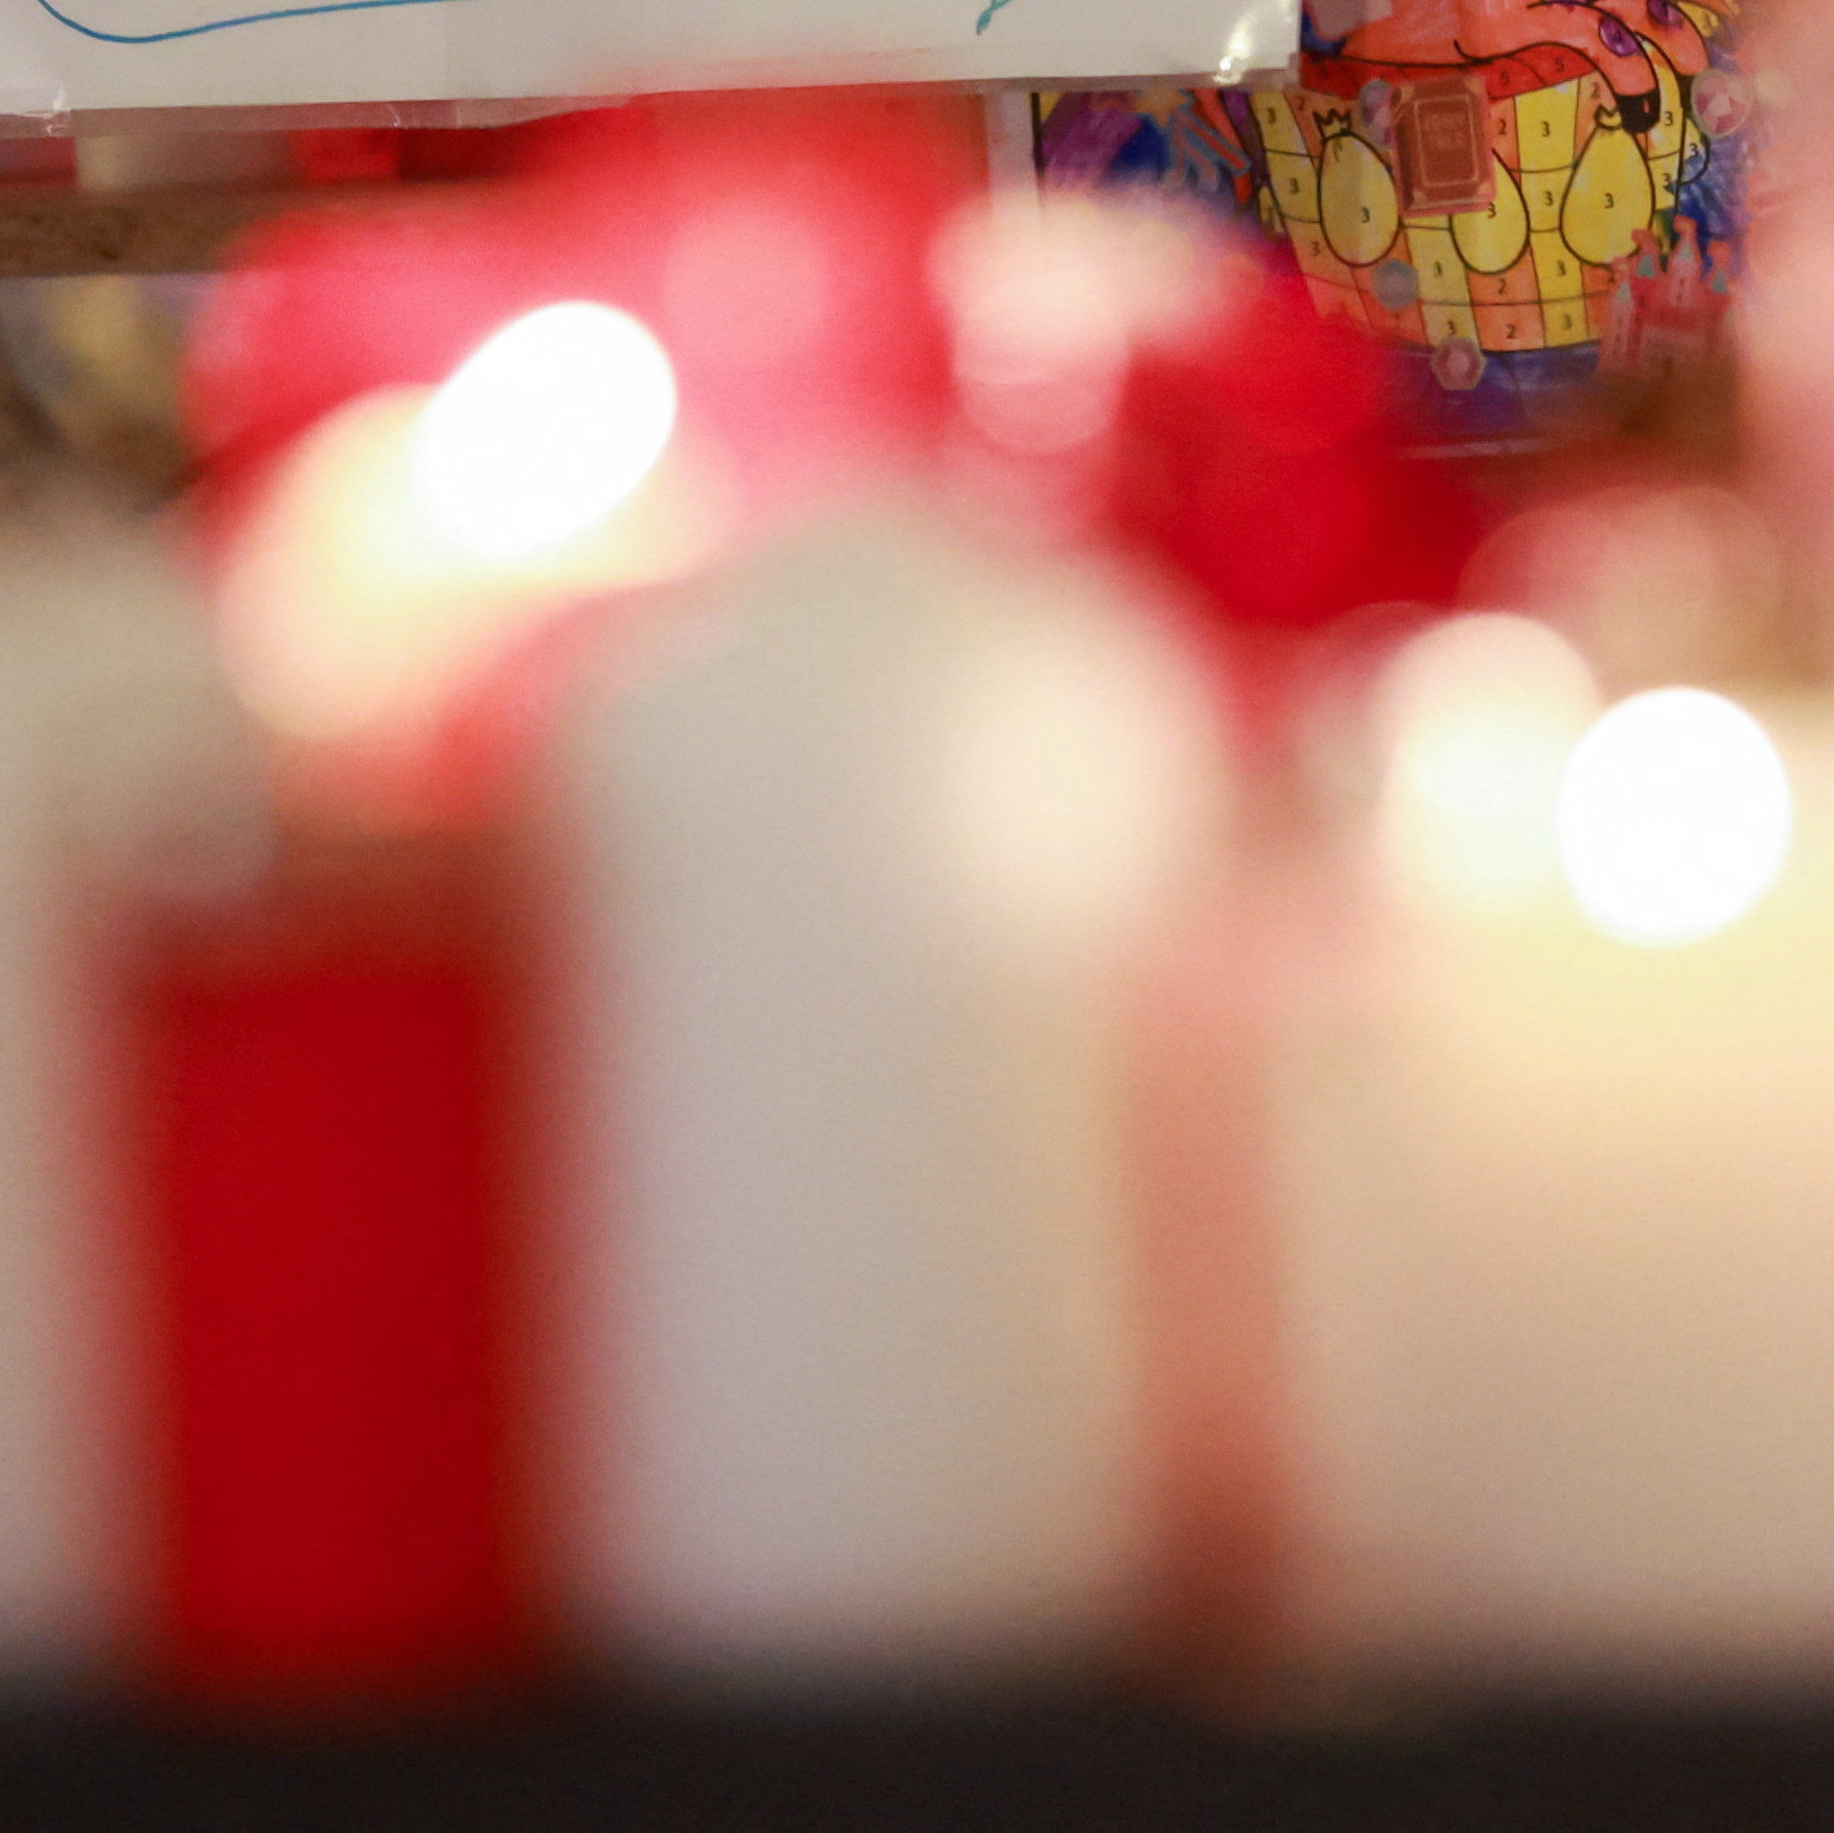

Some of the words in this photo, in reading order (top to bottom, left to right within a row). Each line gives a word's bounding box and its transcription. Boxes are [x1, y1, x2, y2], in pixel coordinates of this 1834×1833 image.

[1498, 119, 1507, 135] 2
[1541, 122, 1551, 137] 3
[1545, 191, 1554, 206] 3
[1605, 193, 1614, 208] 3
[1361, 207, 1370, 223] 3
[1498, 278, 1507, 294] 2
[1507, 324, 1516, 339] 2
